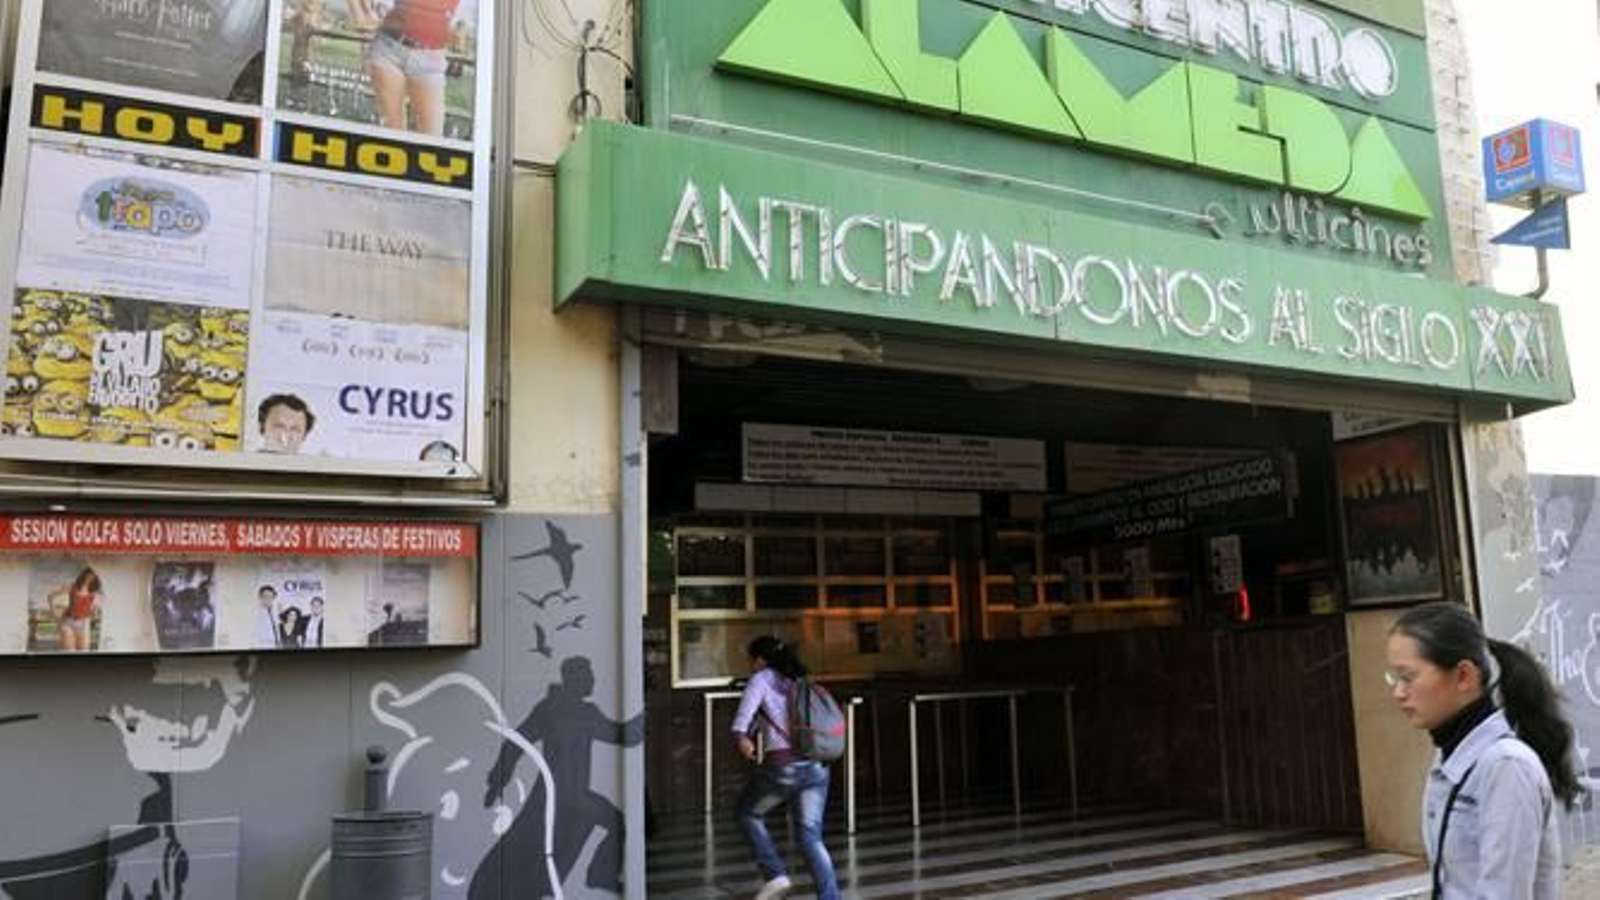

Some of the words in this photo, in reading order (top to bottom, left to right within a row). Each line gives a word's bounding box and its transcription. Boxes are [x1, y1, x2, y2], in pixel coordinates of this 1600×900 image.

[41, 95, 244, 151] HOY
[715, 0, 1430, 220] ALAMEDA
[293, 132, 468, 183] HOY
[322, 229, 371, 252] THE
[375, 234, 425, 260] WAY
[661, 178, 1251, 344] ANTICIPANDONOS
[1269, 282, 1324, 356] AL
[1335, 290, 1459, 370] SIGLO
[1470, 304, 1553, 383] XXI
[92, 331, 164, 379] GRU
[339, 385, 454, 421] CYRUS
[11, 517, 68, 543] SESION
[72, 519, 120, 544] GOLFA
[123, 521, 161, 545] SOLO
[305, 524, 315, 549] Y
[382, 526, 399, 550] DE
[403, 526, 461, 551] FESTIVOS
